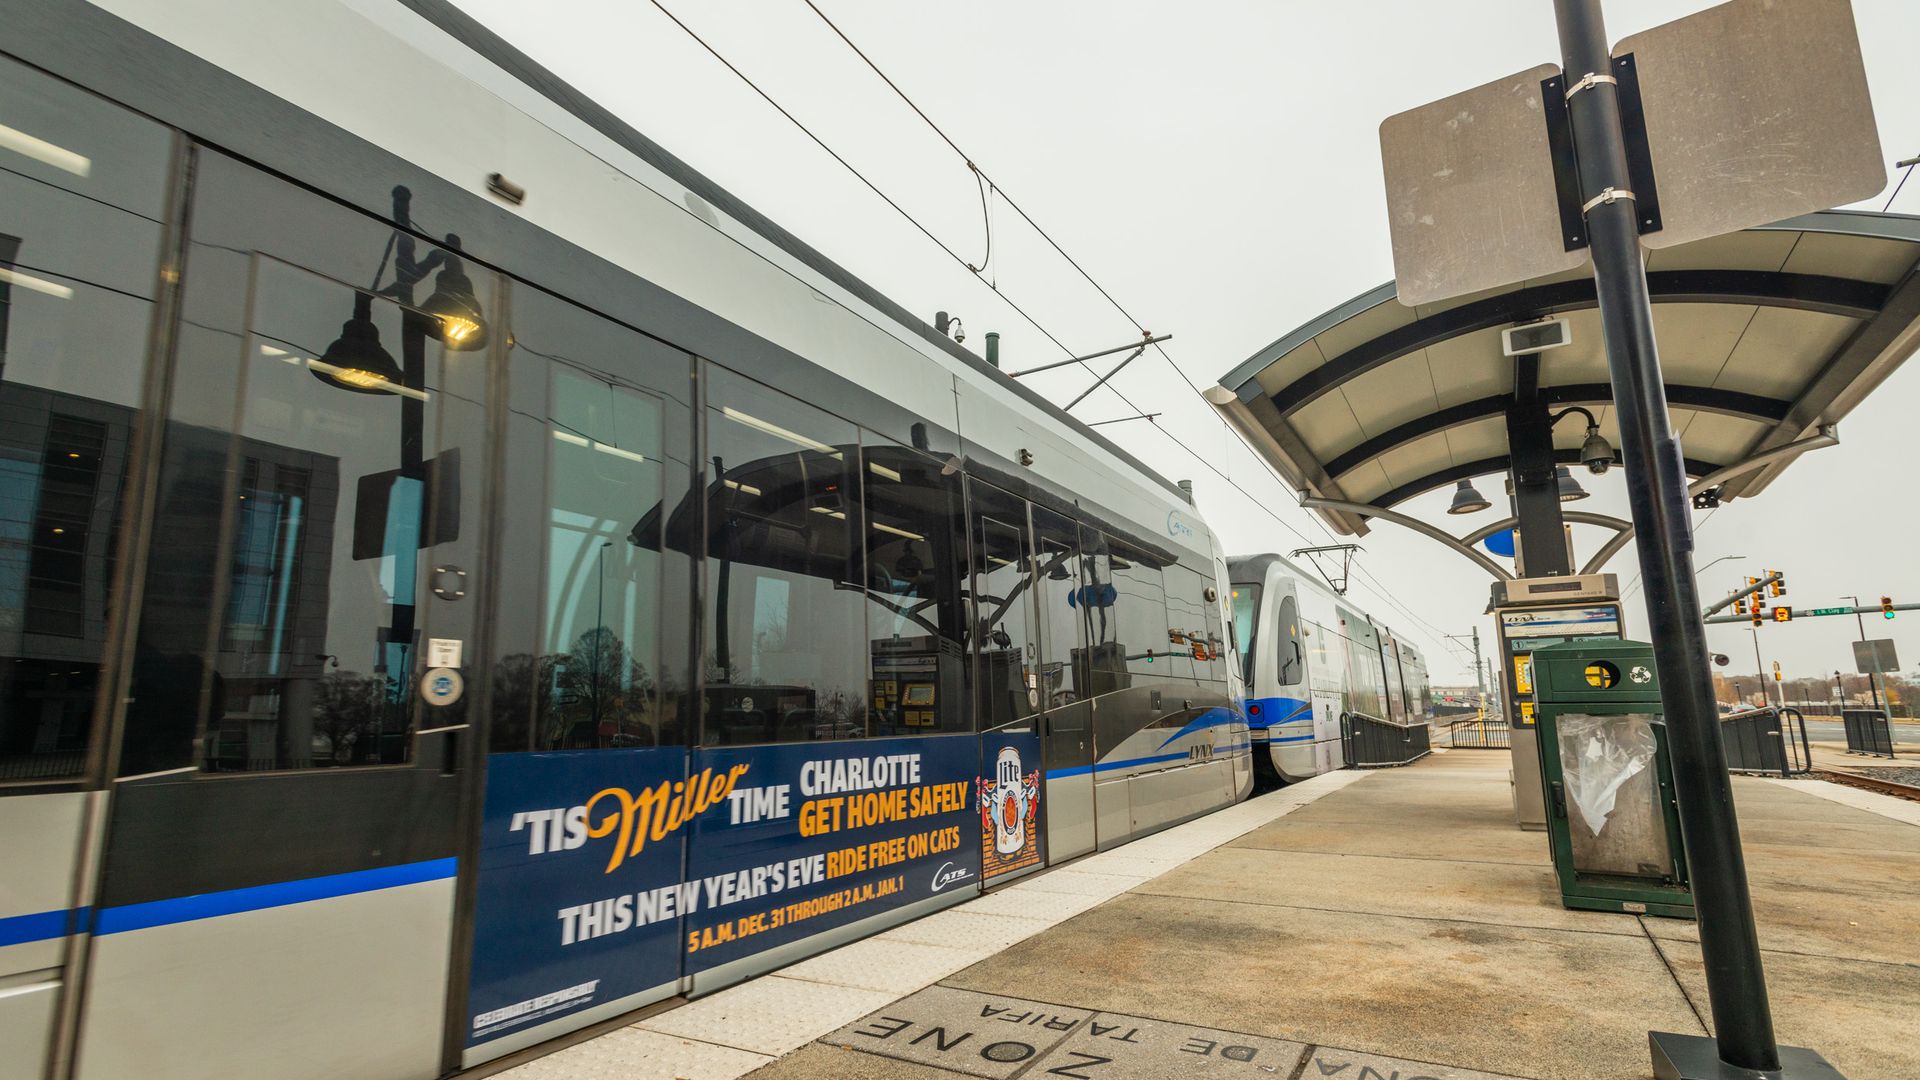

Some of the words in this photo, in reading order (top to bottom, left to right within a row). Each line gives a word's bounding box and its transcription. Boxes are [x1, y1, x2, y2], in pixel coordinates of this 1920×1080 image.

[800, 753, 921, 797] CHARLOTTE
[1189, 744, 1214, 760] LYNX
[585, 763, 750, 874] Miller
[728, 783, 790, 825] TIME
[799, 796, 845, 838] GET
[847, 788, 907, 830] HOME
[909, 780, 969, 818] SAFELY
[557, 894, 633, 946] THIS
[636, 879, 702, 927] NEW
[703, 861, 785, 909] YEAR'S
[787, 853, 825, 890] EVE
[826, 843, 868, 880] RIDE
[869, 836, 906, 870] FREE
[907, 831, 928, 860] ON
[929, 825, 961, 855] CATS
[687, 930, 699, 953] 5
[699, 923, 736, 950] A.M.
[738, 914, 769, 938] DEC.
[770, 906, 785, 929] 31
[785, 892, 844, 925] THROUGH
[844, 890, 851, 907] 2
[851, 882, 875, 905] A.M.
[876, 877, 897, 899] JAN.
[898, 875, 904, 891] 1
[854, 1016, 1113, 1080] ZONE
[980, 1004, 1140, 1044] TARIFA
[1179, 1037, 1260, 1063] DE
